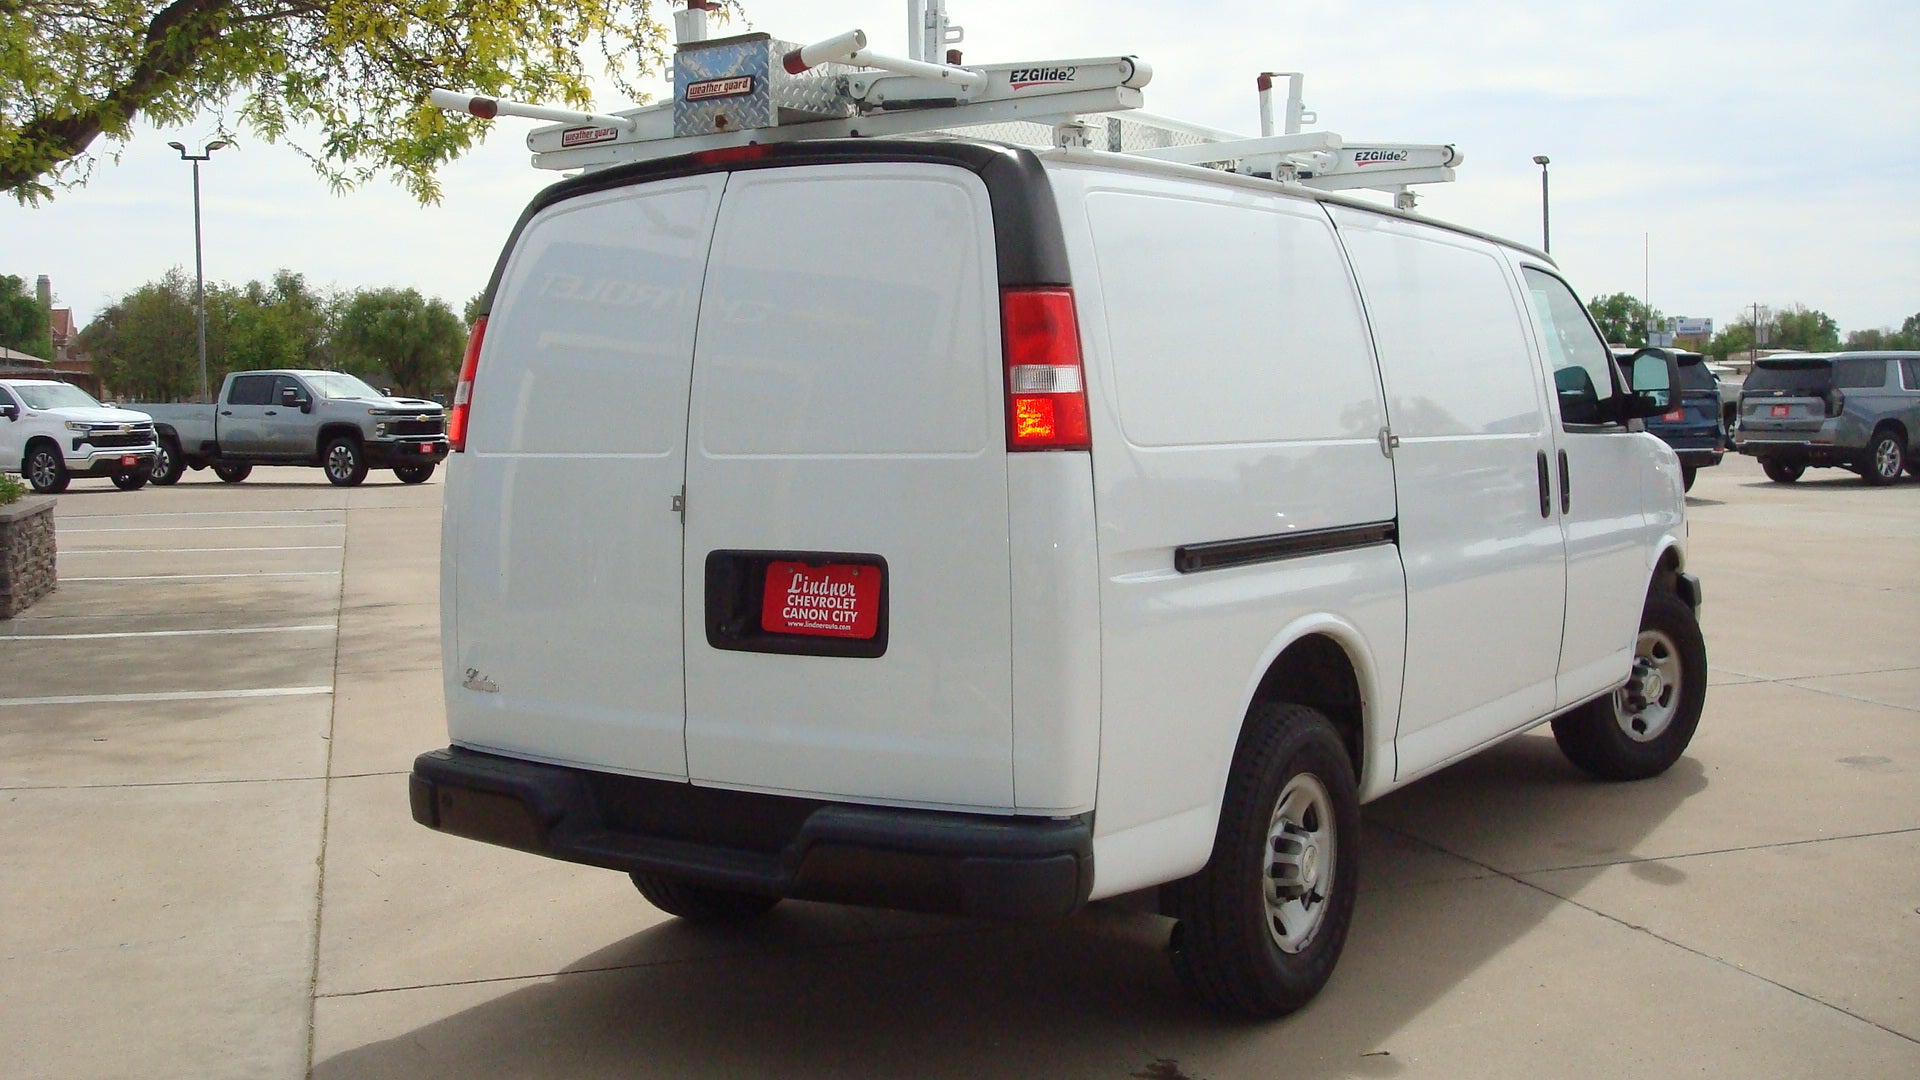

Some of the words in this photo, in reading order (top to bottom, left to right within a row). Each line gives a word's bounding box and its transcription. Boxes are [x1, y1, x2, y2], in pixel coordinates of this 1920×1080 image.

[1009, 66, 1076, 83] EZGlide2
[690, 82, 722, 95] weather
[724, 78, 749, 93] guard
[565, 130, 593, 142] weather
[1354, 150, 1408, 162] EZGlide2
[787, 573, 856, 597] Lindner
[787, 595, 857, 610] CHEVROLET
[782, 607, 829, 621] CANON
[832, 610, 858, 623] CITY
